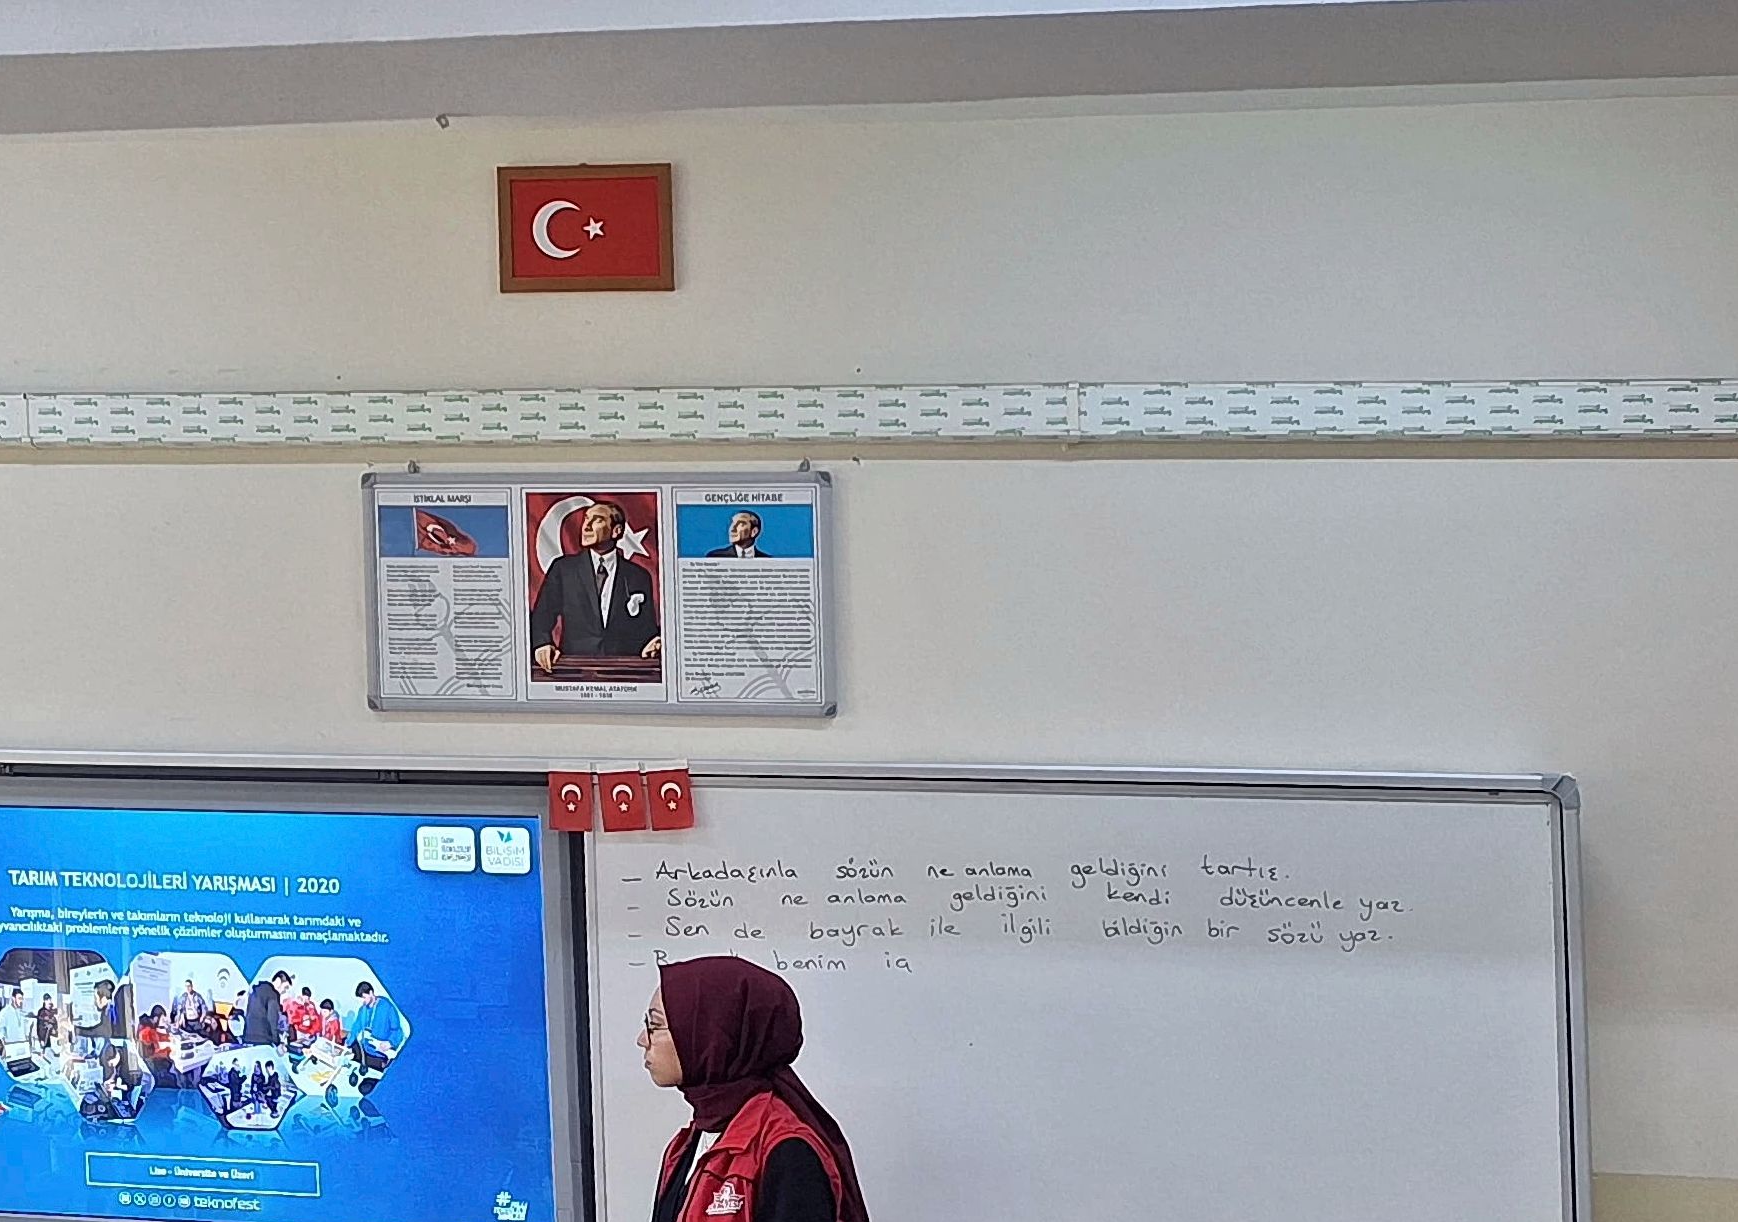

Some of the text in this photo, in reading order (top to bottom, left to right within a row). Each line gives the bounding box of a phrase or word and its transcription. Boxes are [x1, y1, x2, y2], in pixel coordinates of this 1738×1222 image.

[704, 492, 783, 504] GENÇLİĞE HİTABE
[655, 859, 798, 883] Arkadaşınla
[836, 857, 894, 879] sözün
[927, 865, 955, 879] ne
[965, 861, 1033, 878] anlama
[8, 869, 58, 886] TARIM
[60, 871, 187, 890] TEKNOLOJİLERİ
[192, 874, 276, 895] YARIŞMASI
[297, 878, 340, 894] 2020
[667, 888, 734, 908] Sözün
[781, 893, 809, 906] ne
[827, 888, 907, 904] anlama
[949, 884, 1047, 912] geldiğini
[1106, 881, 1170, 906] kendi
[11, 906, 362, 928] Yarışma, bireylerin ve takımların teknoloji kullanarak tarımdaki ve
[65, 922, 130, 936] problemlere
[131, 923, 170, 938] yönelik
[173, 926, 223, 940] çözümler
[224, 926, 296, 941] oluşturmasını
[299, 929, 389, 944] amaçlamaktadır.
[665, 916, 710, 937] Sen
[733, 922, 766, 939] de
[810, 918, 905, 947] bayrak
[929, 915, 961, 937] ile
[1000, 912, 1051, 944] ilgili
[1207, 918, 1240, 938] bir
[1267, 920, 1324, 945] sözü
[1339, 930, 1394, 952] yaz.
[772, 949, 847, 971] benim
[193, 1195, 261, 1210] teknofest
